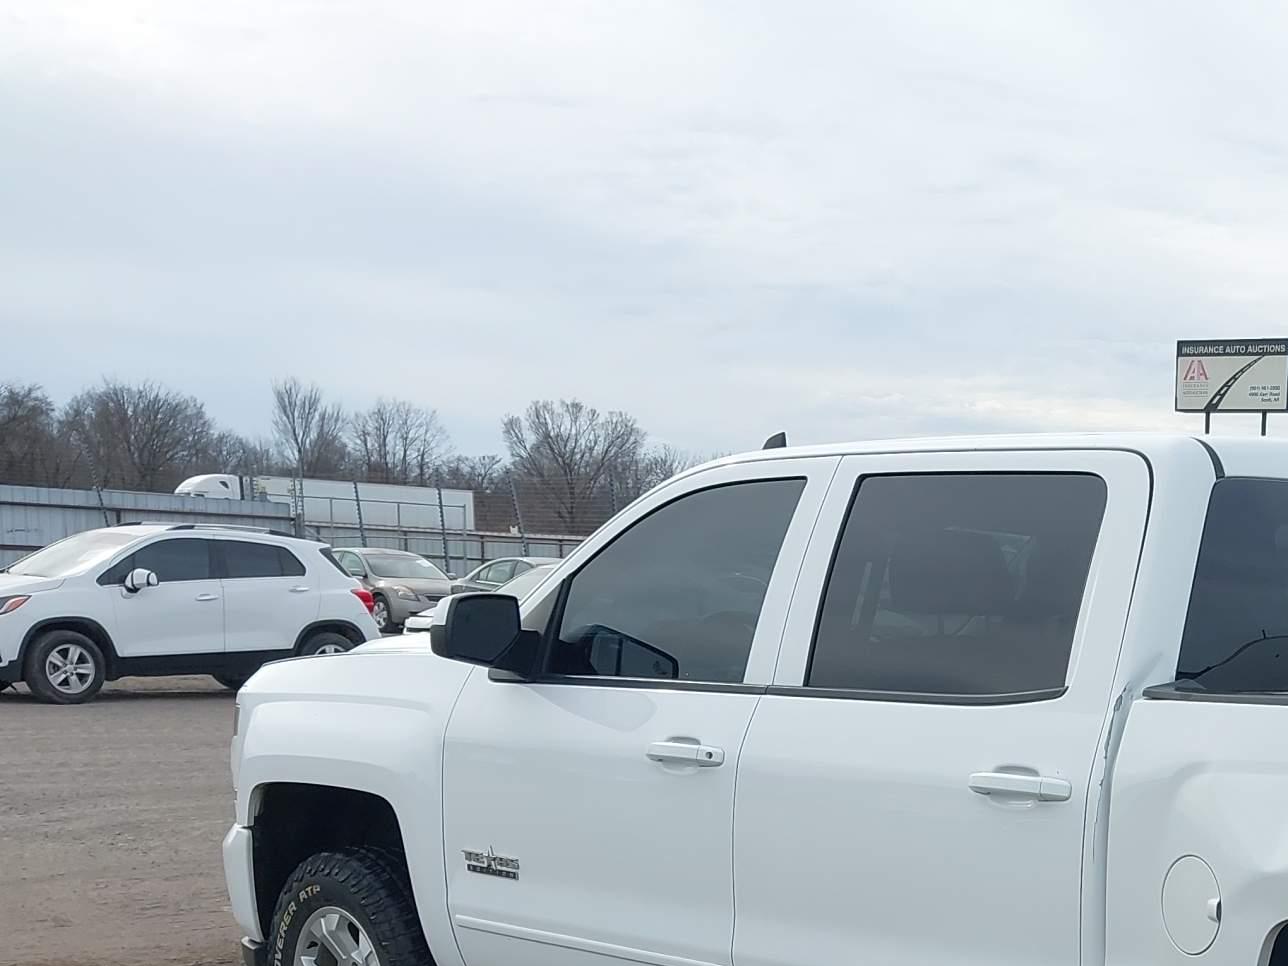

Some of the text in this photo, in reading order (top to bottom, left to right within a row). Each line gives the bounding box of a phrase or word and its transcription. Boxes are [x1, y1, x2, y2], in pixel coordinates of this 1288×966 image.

[1182, 344, 1286, 354] INSURANCE AUTO AUCTIONS
[299, 884, 320, 902] ATP
